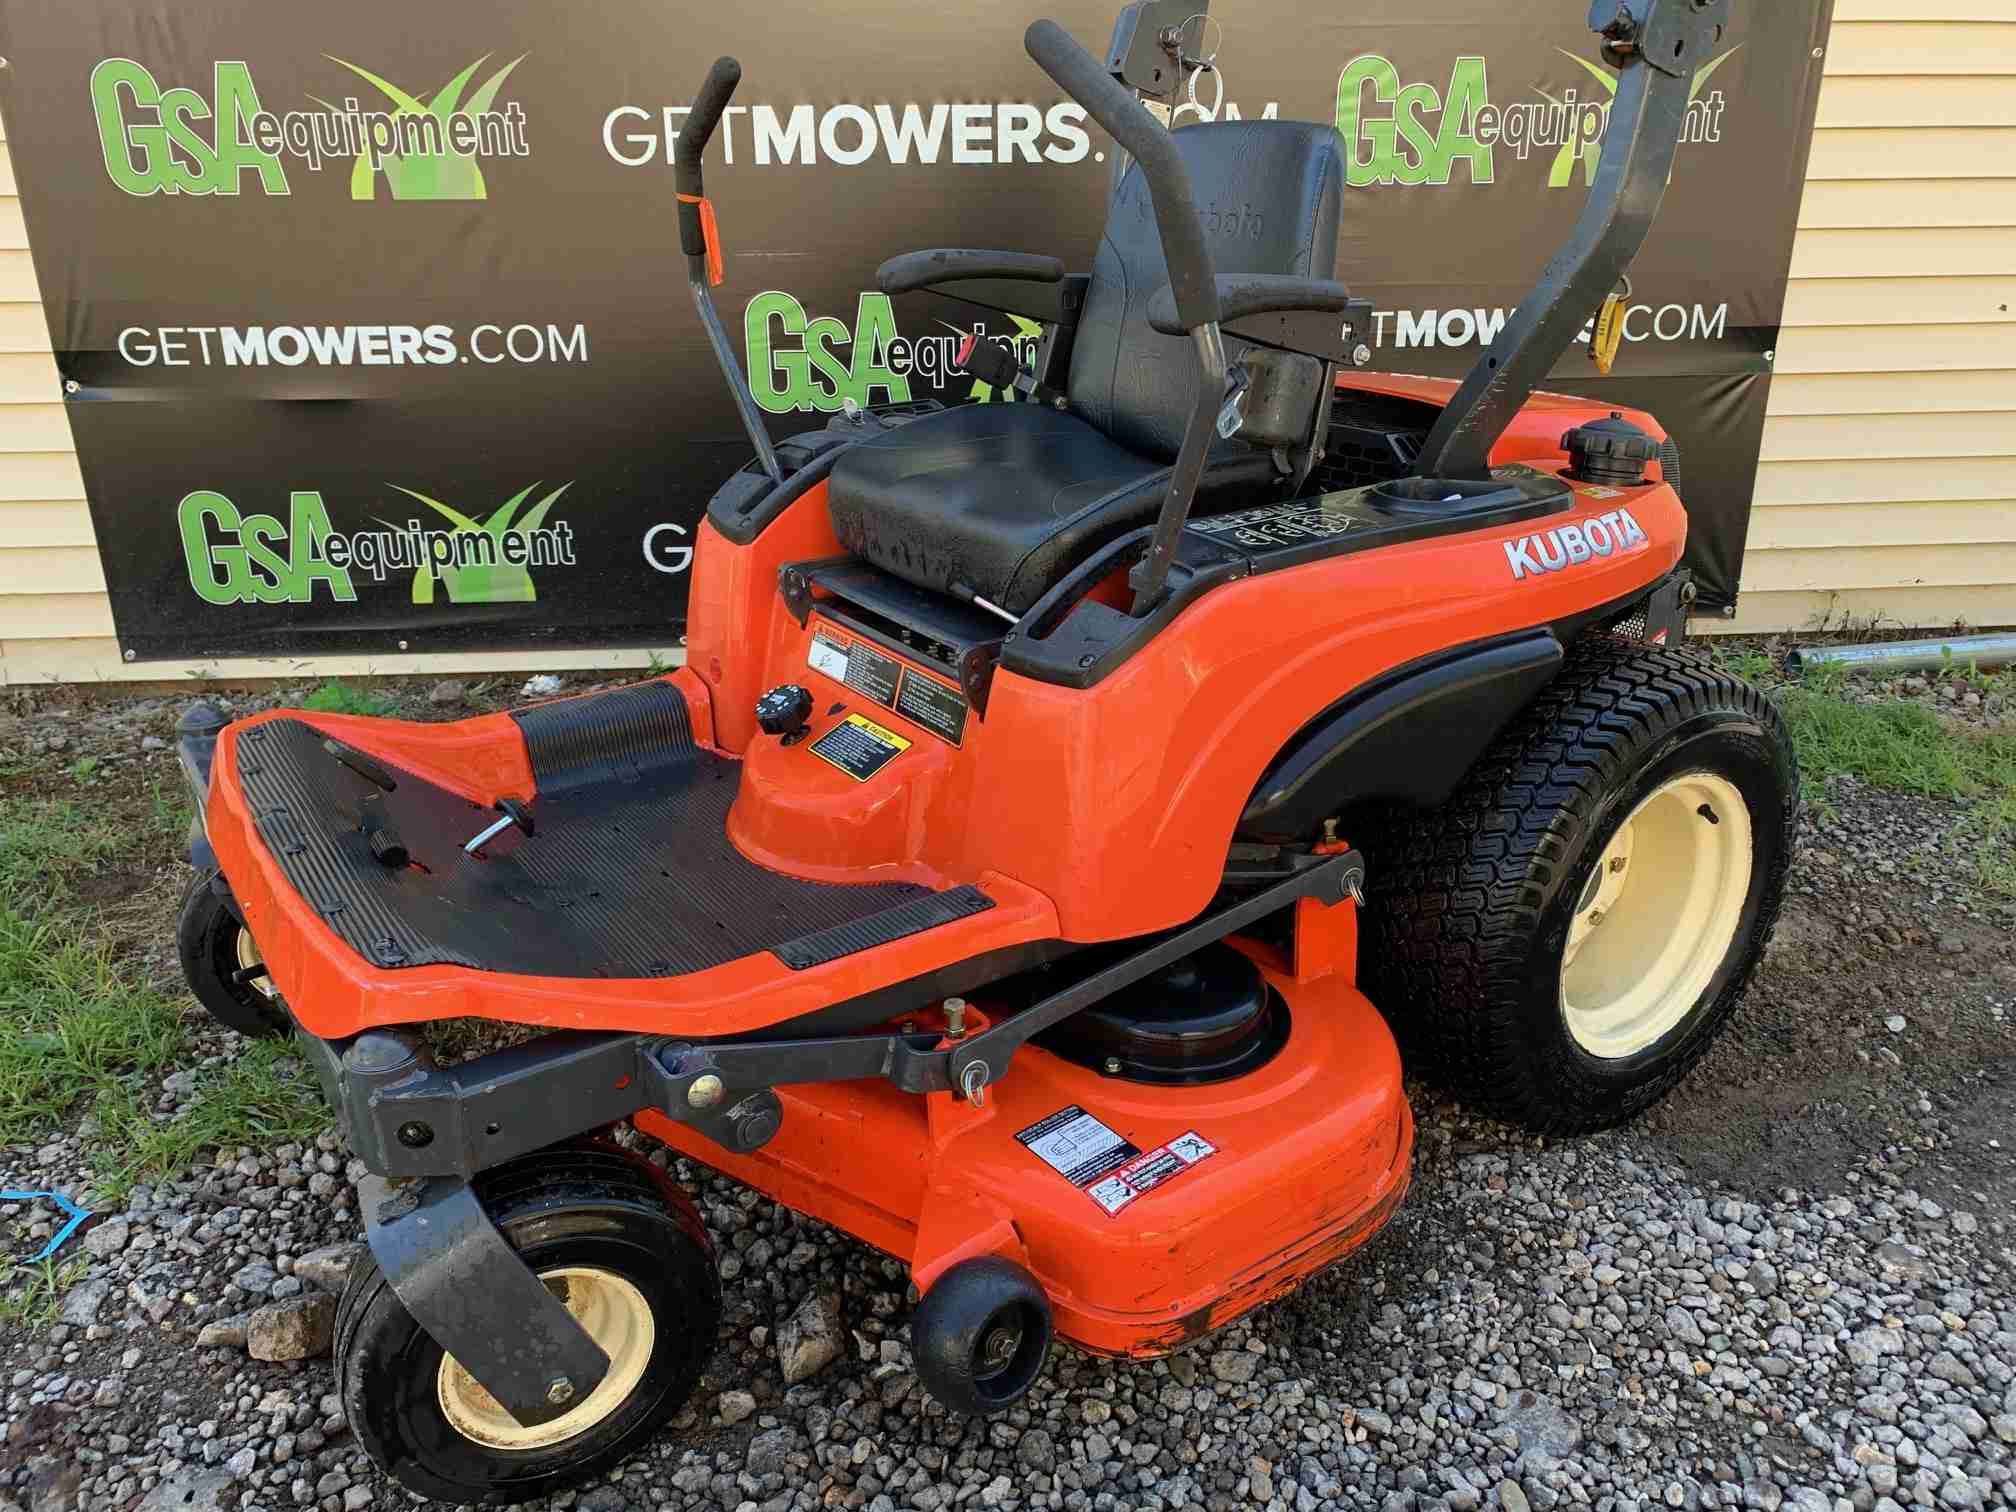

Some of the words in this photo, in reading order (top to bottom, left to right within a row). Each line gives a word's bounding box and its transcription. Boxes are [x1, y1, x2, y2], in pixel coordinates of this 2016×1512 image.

[1472, 89, 1724, 159] equipnt
[118, 323, 590, 367] GETMOWERS.COM
[1503, 508, 1649, 581] KUBOTA
